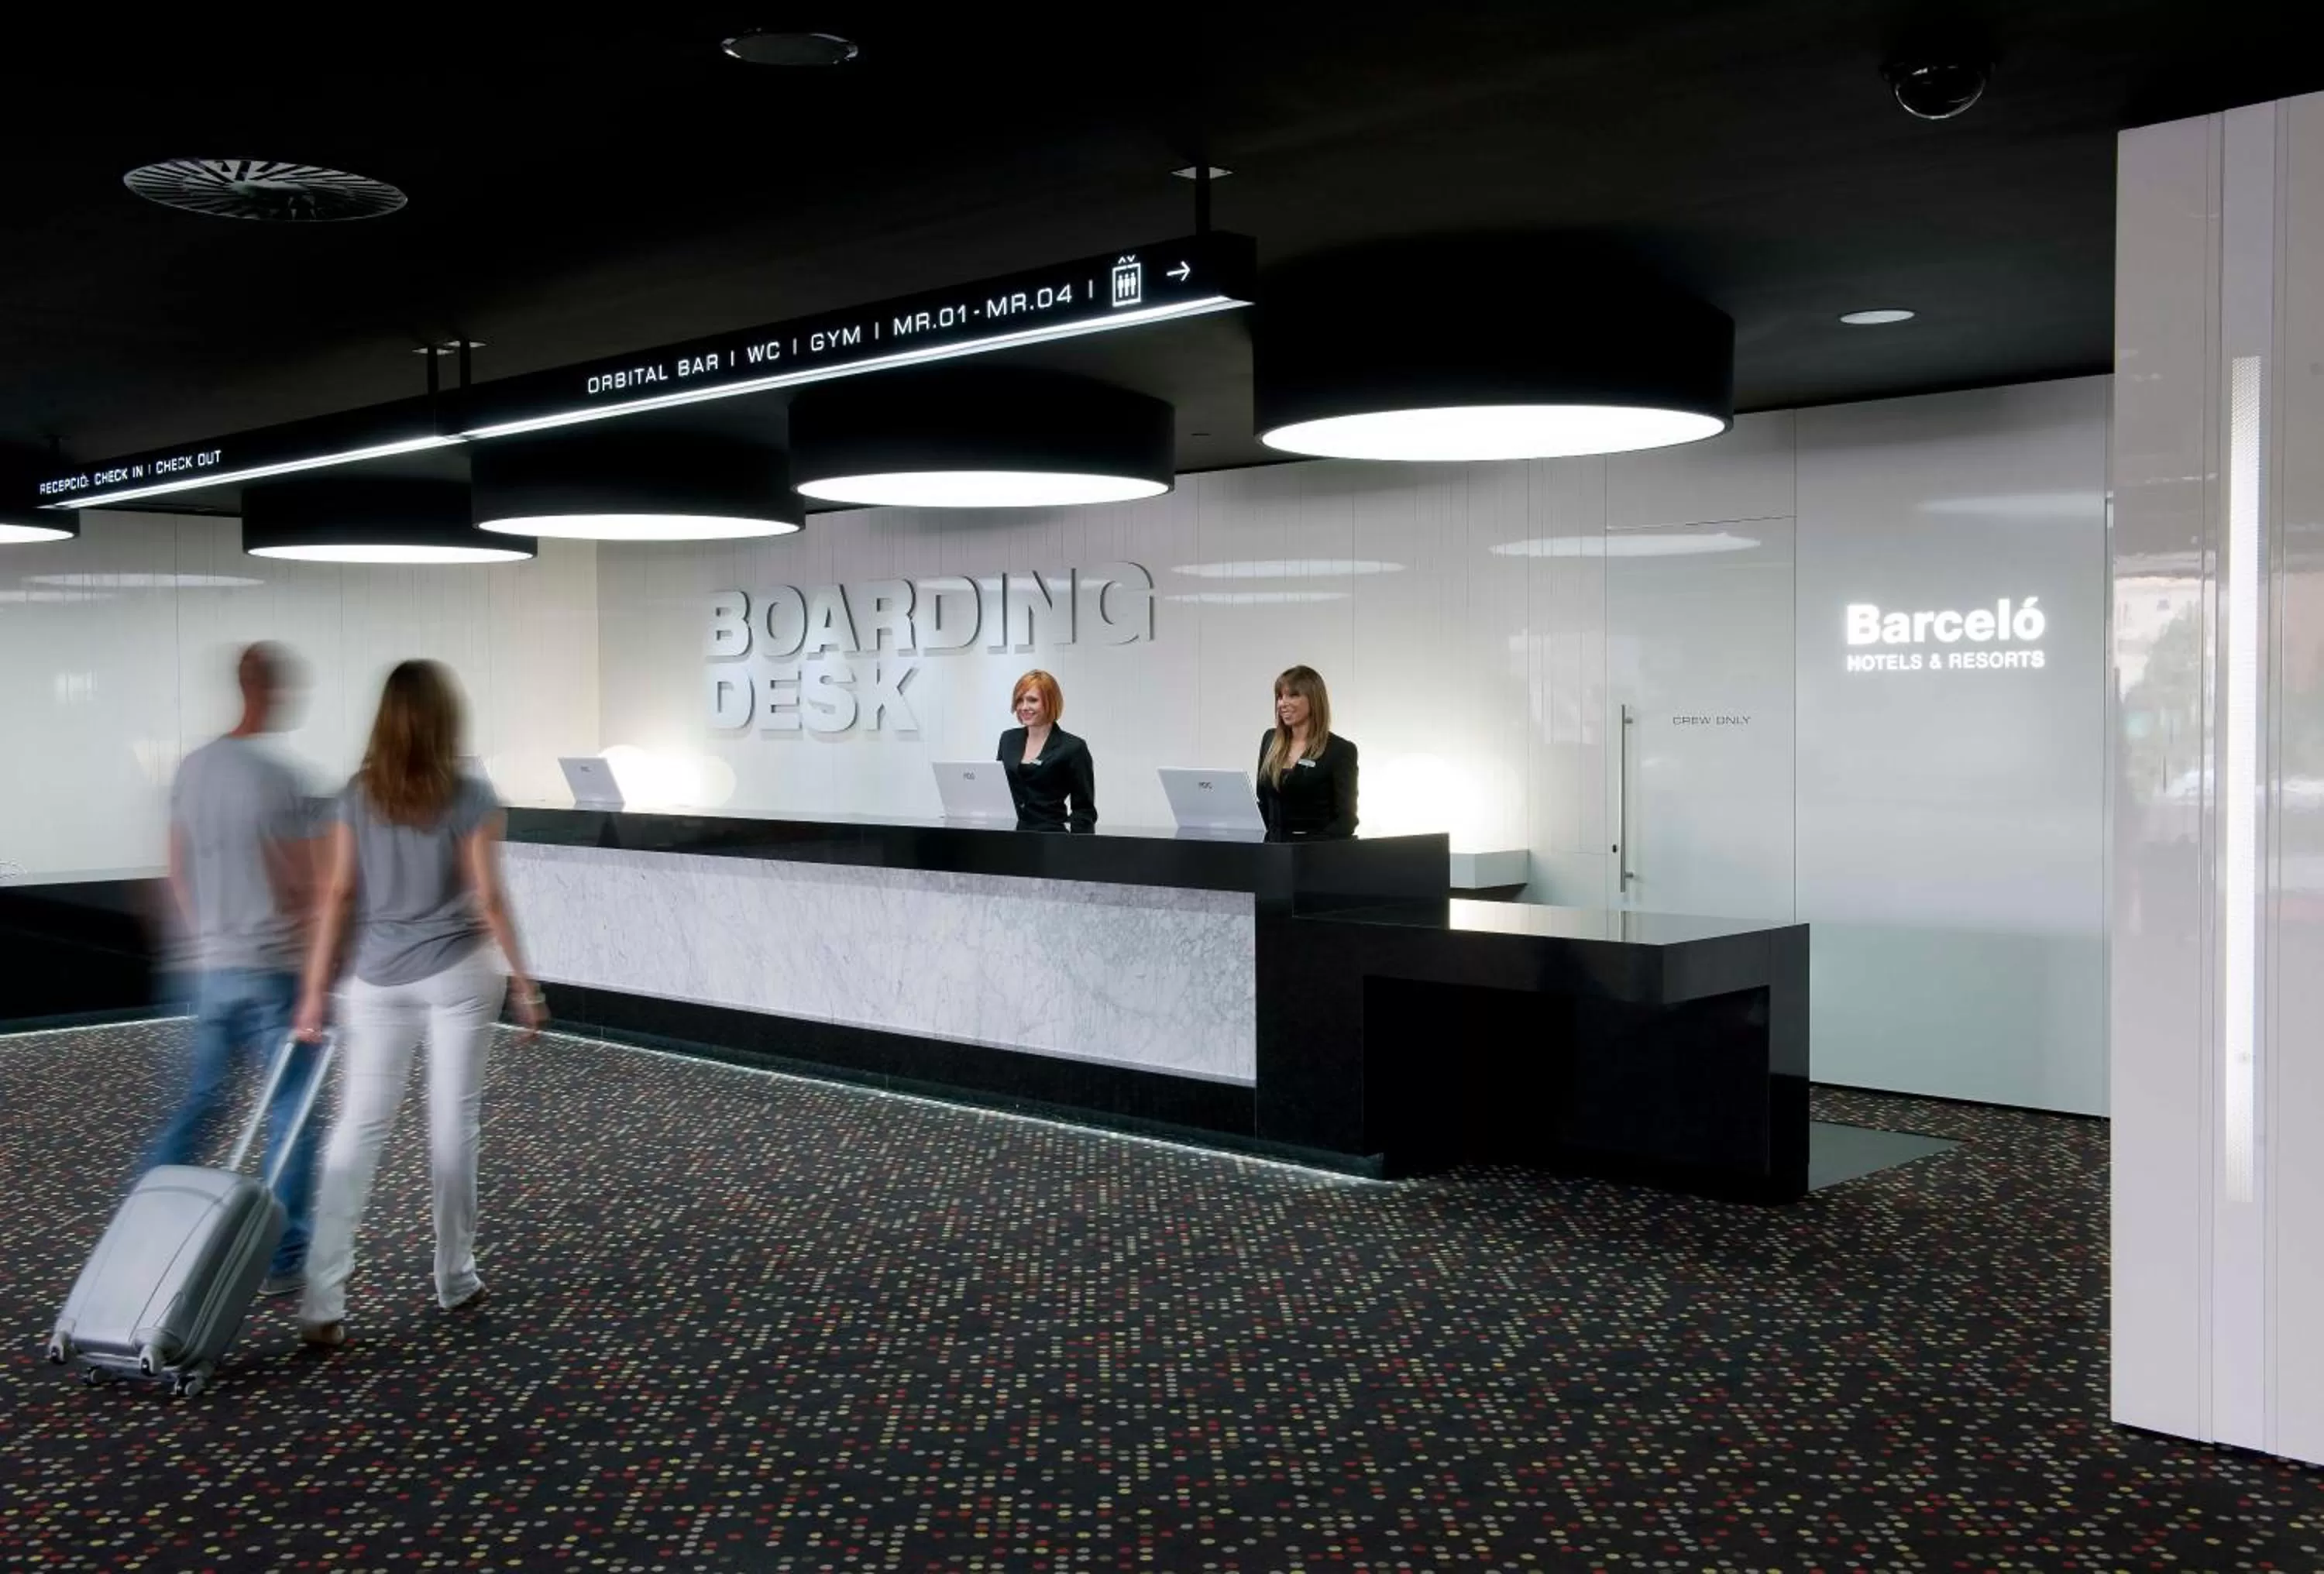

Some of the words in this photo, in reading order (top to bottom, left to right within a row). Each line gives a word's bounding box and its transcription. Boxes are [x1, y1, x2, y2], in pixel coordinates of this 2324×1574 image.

[587, 364, 669, 394] ORBITAL
[678, 353, 718, 377] BAR
[747, 341, 780, 363] WC
[810, 325, 861, 352] GYM
[94, 468, 128, 486] CHECK
[132, 465, 143, 478] IN
[156, 455, 193, 475] CHECK
[198, 449, 222, 466] OUT
[705, 561, 1155, 658] BOARDING
[1846, 596, 2045, 645] Barceló
[1846, 653, 1923, 672] HOTELS
[1929, 653, 1942, 670] &
[1948, 650, 2045, 668] RESORTS
[705, 664, 920, 734] DESK
[1673, 716, 1711, 726] CREW
[1716, 716, 1752, 726] ONLY
